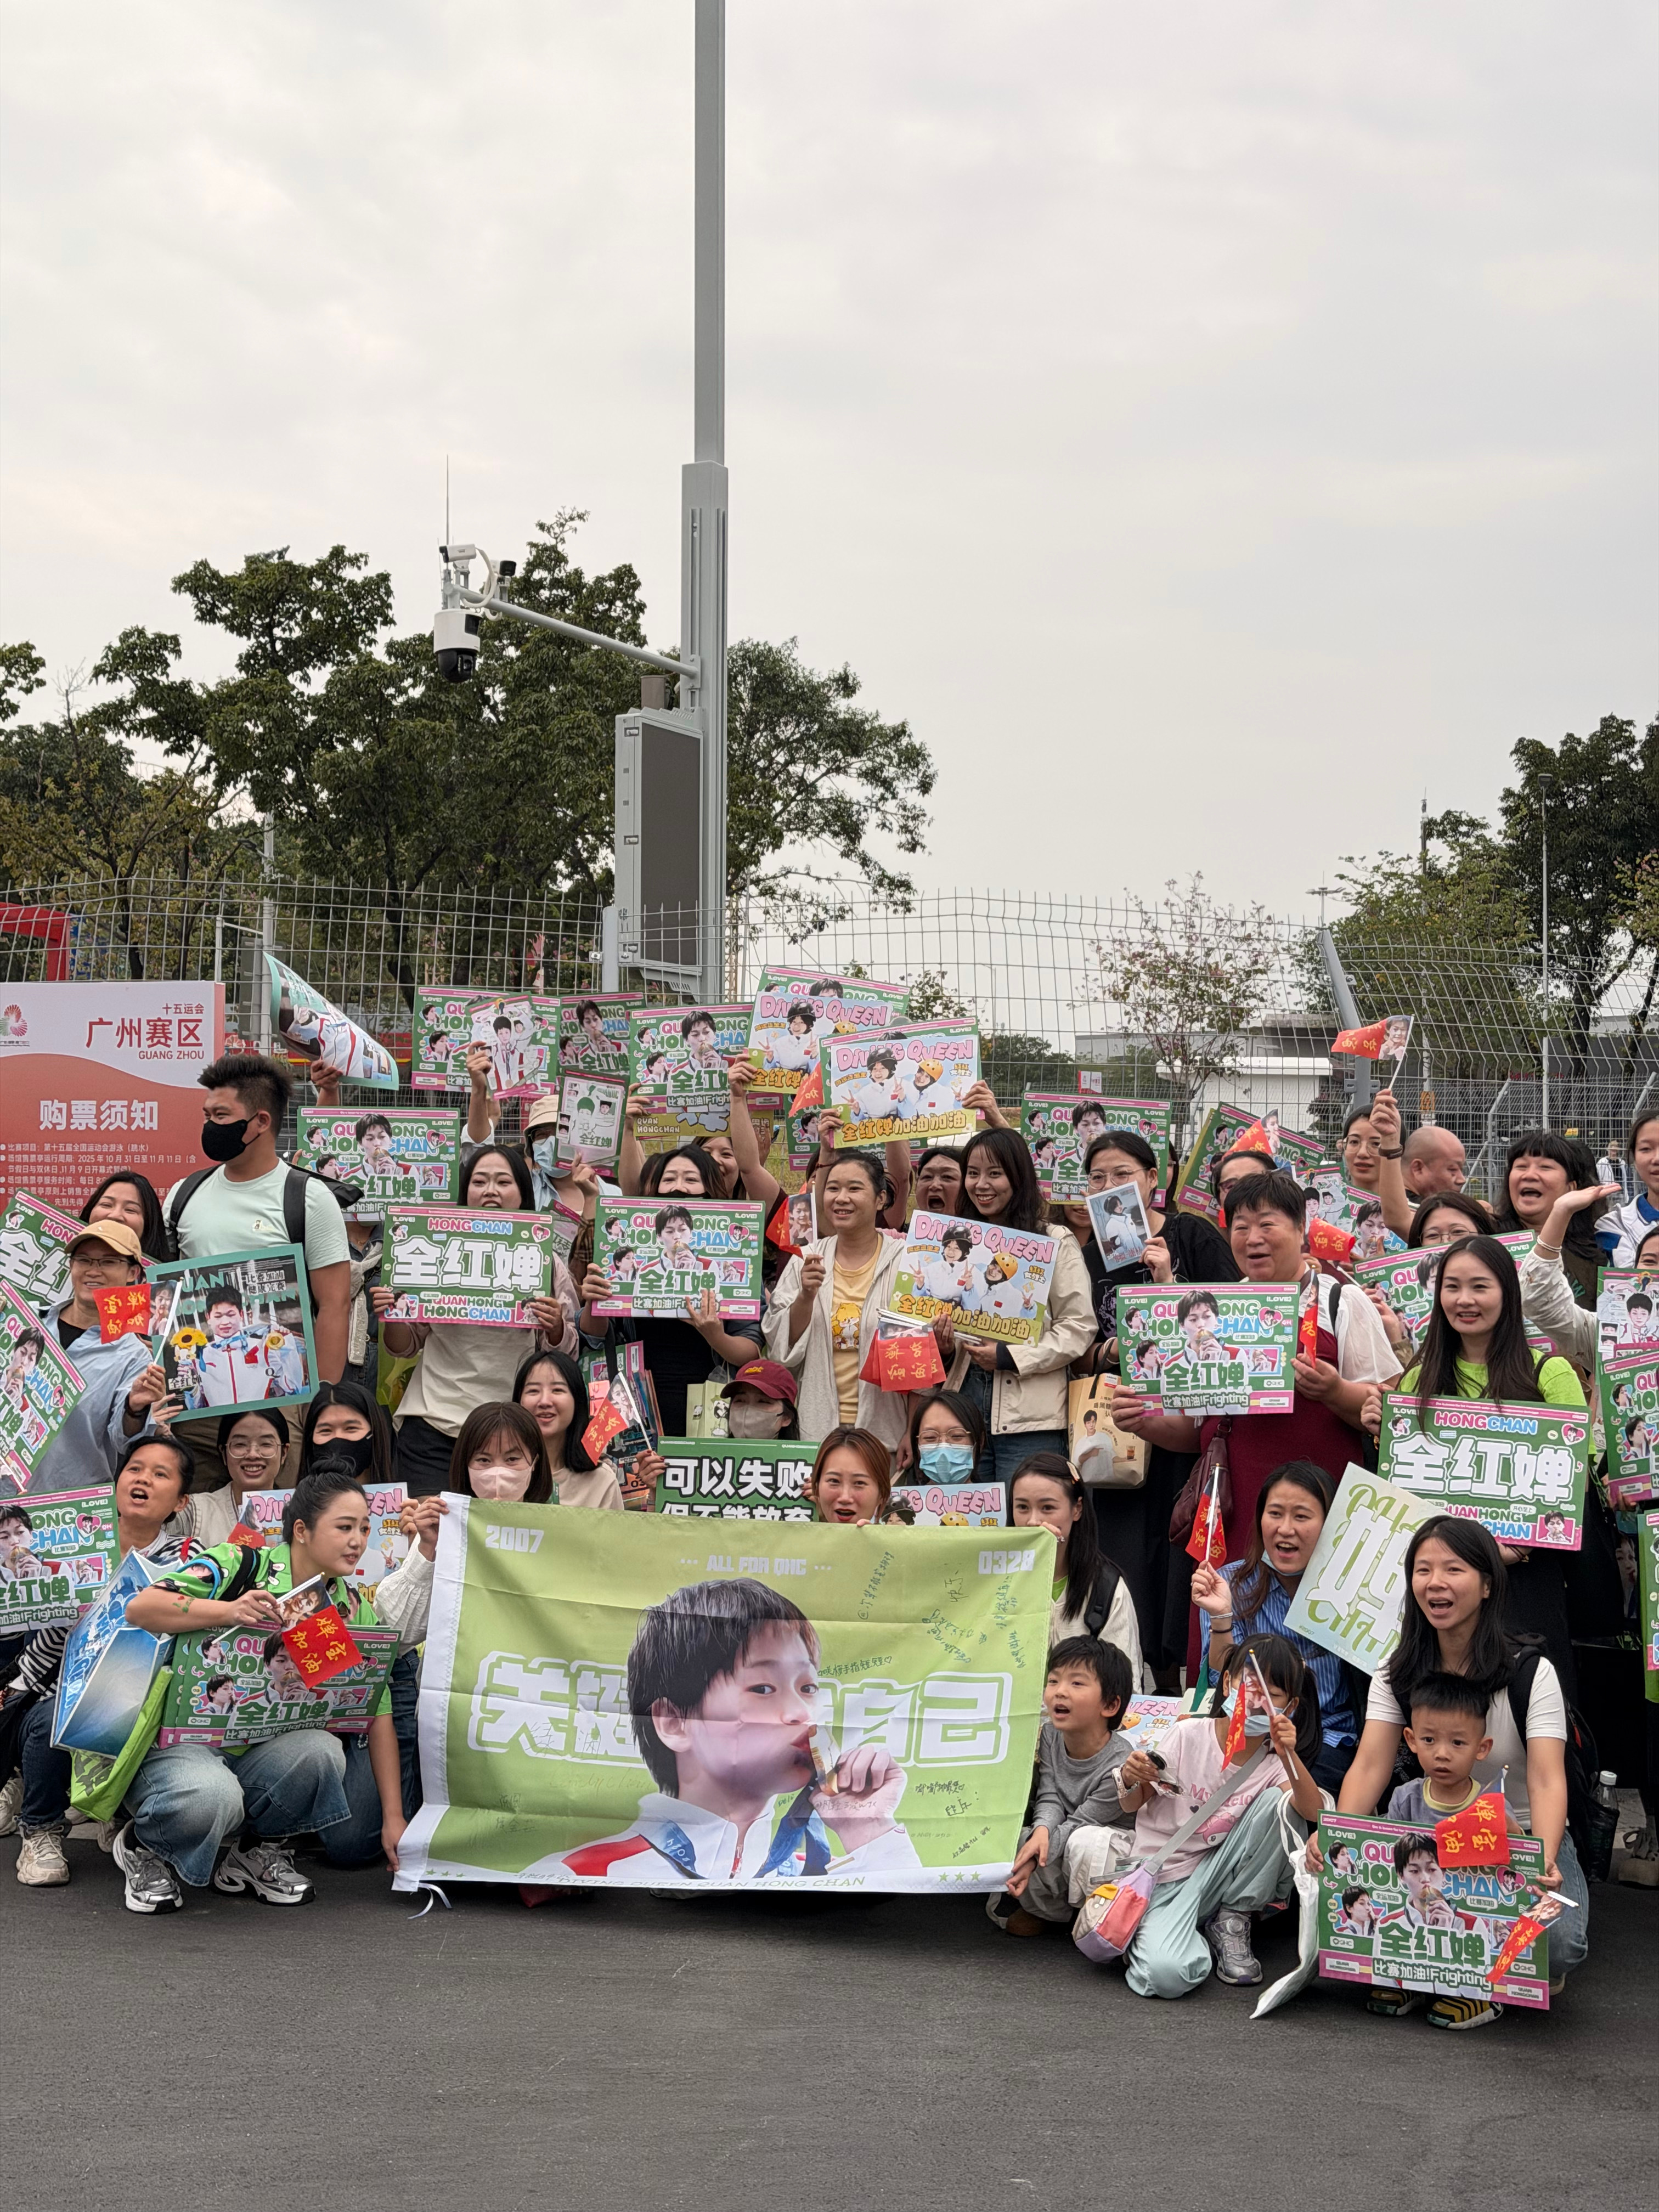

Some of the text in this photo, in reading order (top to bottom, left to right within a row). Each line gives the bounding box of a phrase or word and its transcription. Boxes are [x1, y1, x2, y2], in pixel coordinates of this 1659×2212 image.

[162, 1003, 205, 1015] 十五运会
[825, 1000, 888, 1026] QUEEN
[86, 1017, 203, 1048] 广州赛区
[138, 1050, 205, 1060] GUANG ZHOU
[907, 1039, 973, 1061] QUEEN
[40, 1099, 159, 1131] 购票须知
[842, 1110, 967, 1143] 全红婵加油加油
[427, 1218, 514, 1235] HONGCHAN
[984, 1227, 1054, 1263] QUEEN
[392, 1237, 543, 1290] 全红婵
[182, 1272, 224, 1293] UAN
[639, 1269, 716, 1295] 全红婵
[424, 1306, 511, 1321] HONGCHAN
[898, 1294, 1030, 1340] 全红婵加油加油
[1164, 1361, 1245, 1392] 全红婵
[1435, 1411, 1538, 1435] HONGCHAN
[663, 1457, 814, 1499] 可以失败
[1391, 1434, 1573, 1502] 全红婵
[926, 1487, 1001, 1516] QUEEN
[486, 1525, 544, 1553] 2007
[707, 1555, 806, 1576] ALL FOR QHC
[978, 1549, 1036, 1575] 0328
[234, 1700, 329, 1727] 全红婵
[753, 1880, 808, 1888] HONG
[812, 1876, 865, 1888] CHAN
[1379, 1924, 1485, 1968] 全红婵
